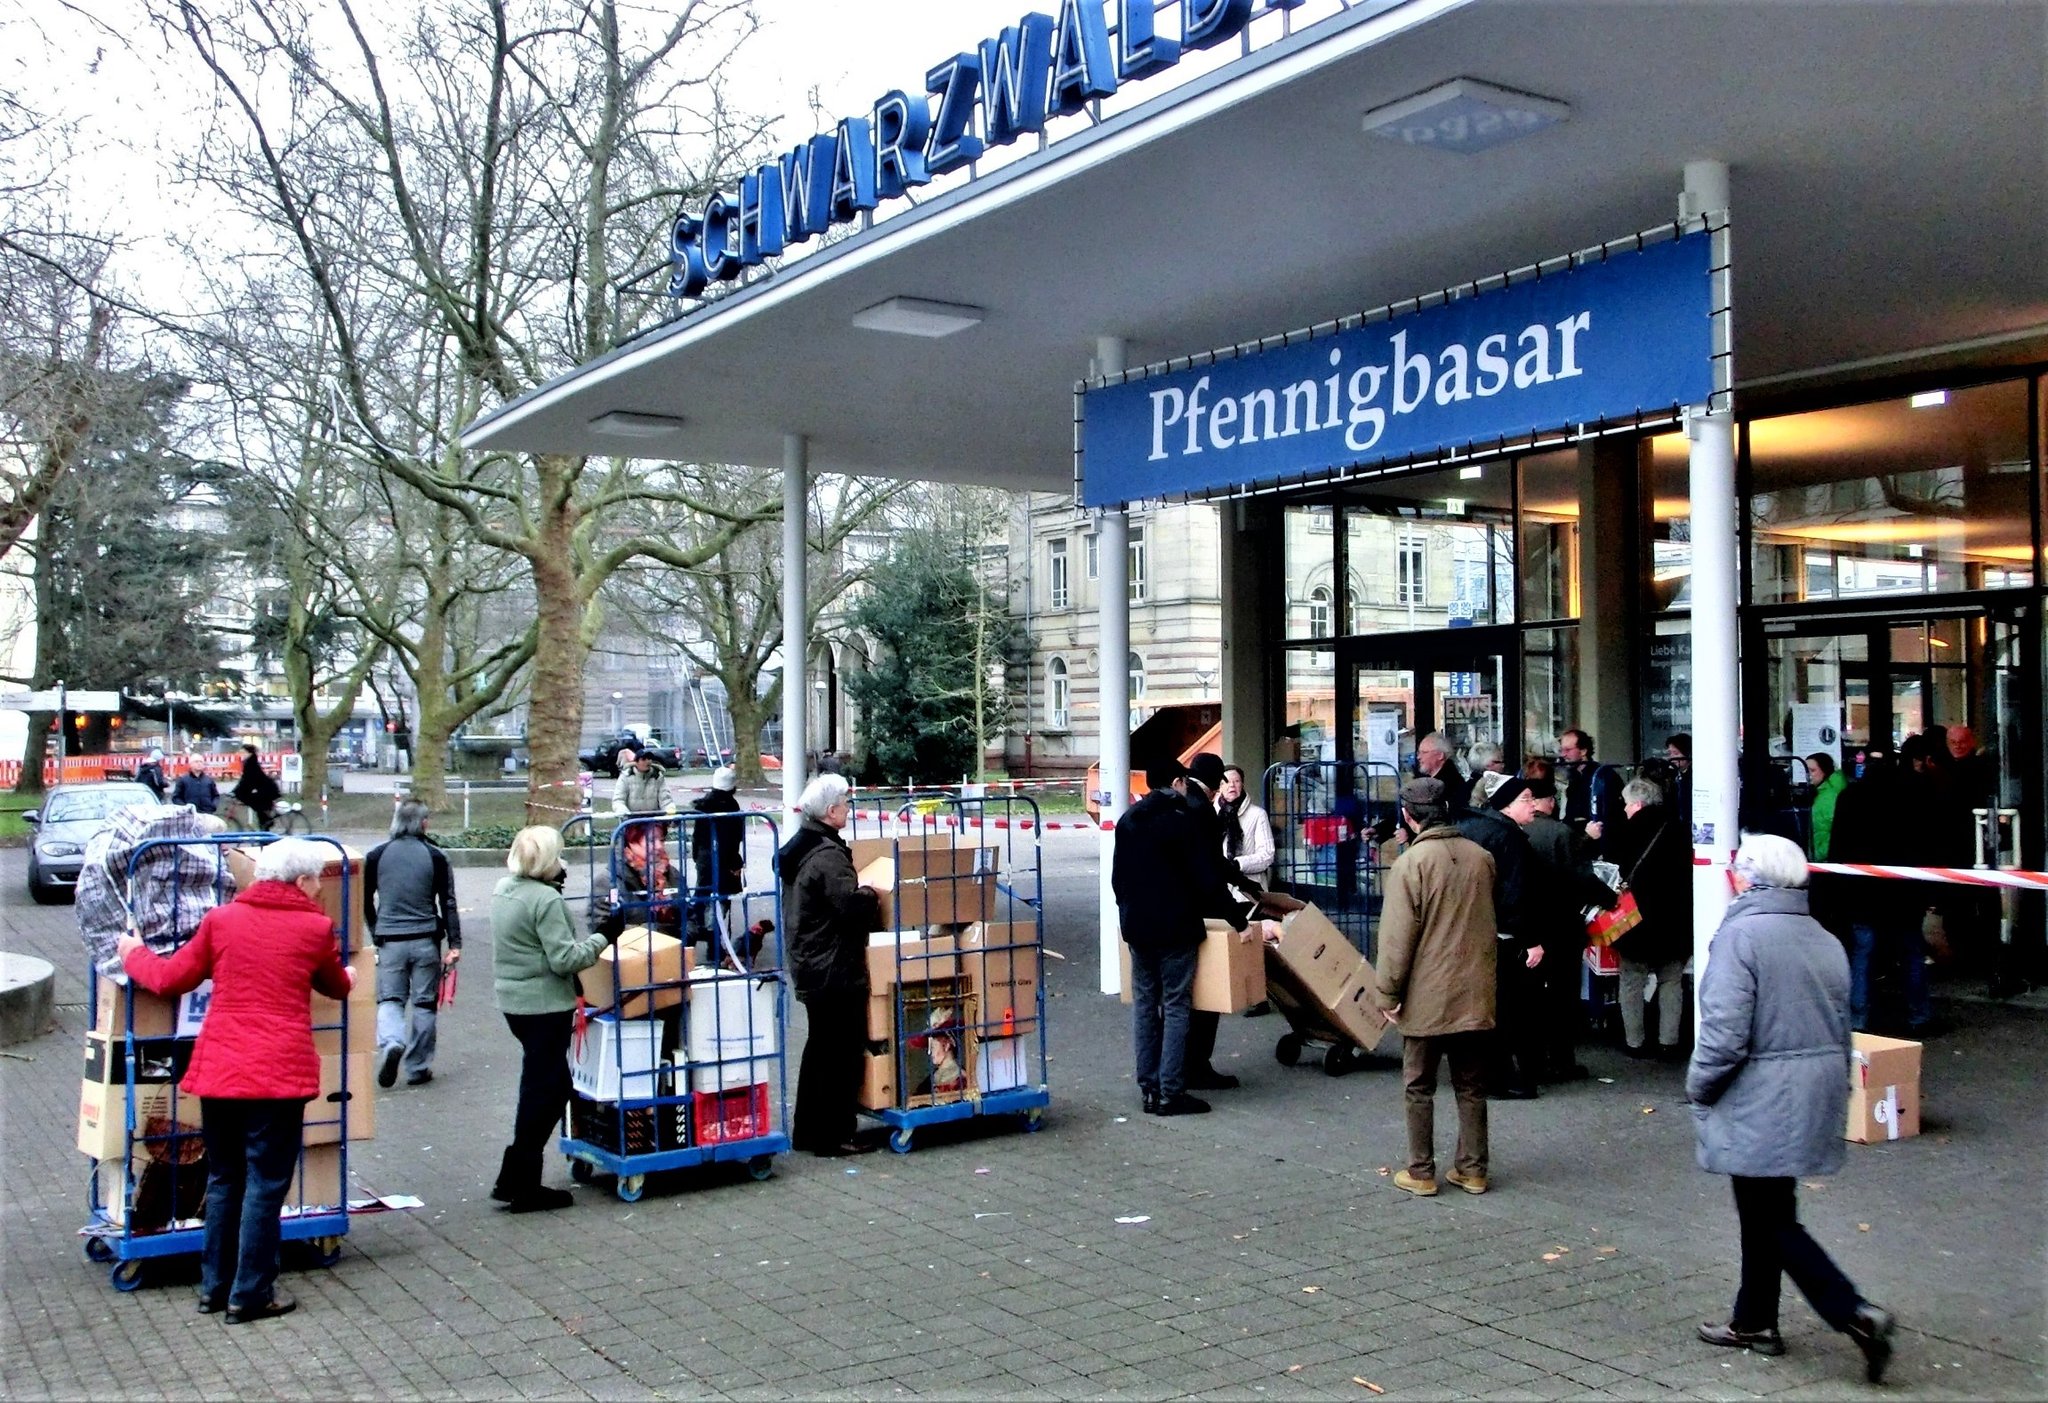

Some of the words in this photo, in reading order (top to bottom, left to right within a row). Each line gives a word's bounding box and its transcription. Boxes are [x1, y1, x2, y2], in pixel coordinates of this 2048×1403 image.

[669, 0, 1304, 297] SCHWARZWAL
[1147, 310, 1591, 452] Pfennigbasar
[1650, 644, 1676, 656] Liebe
[1446, 698, 1490, 718] ELVIS
